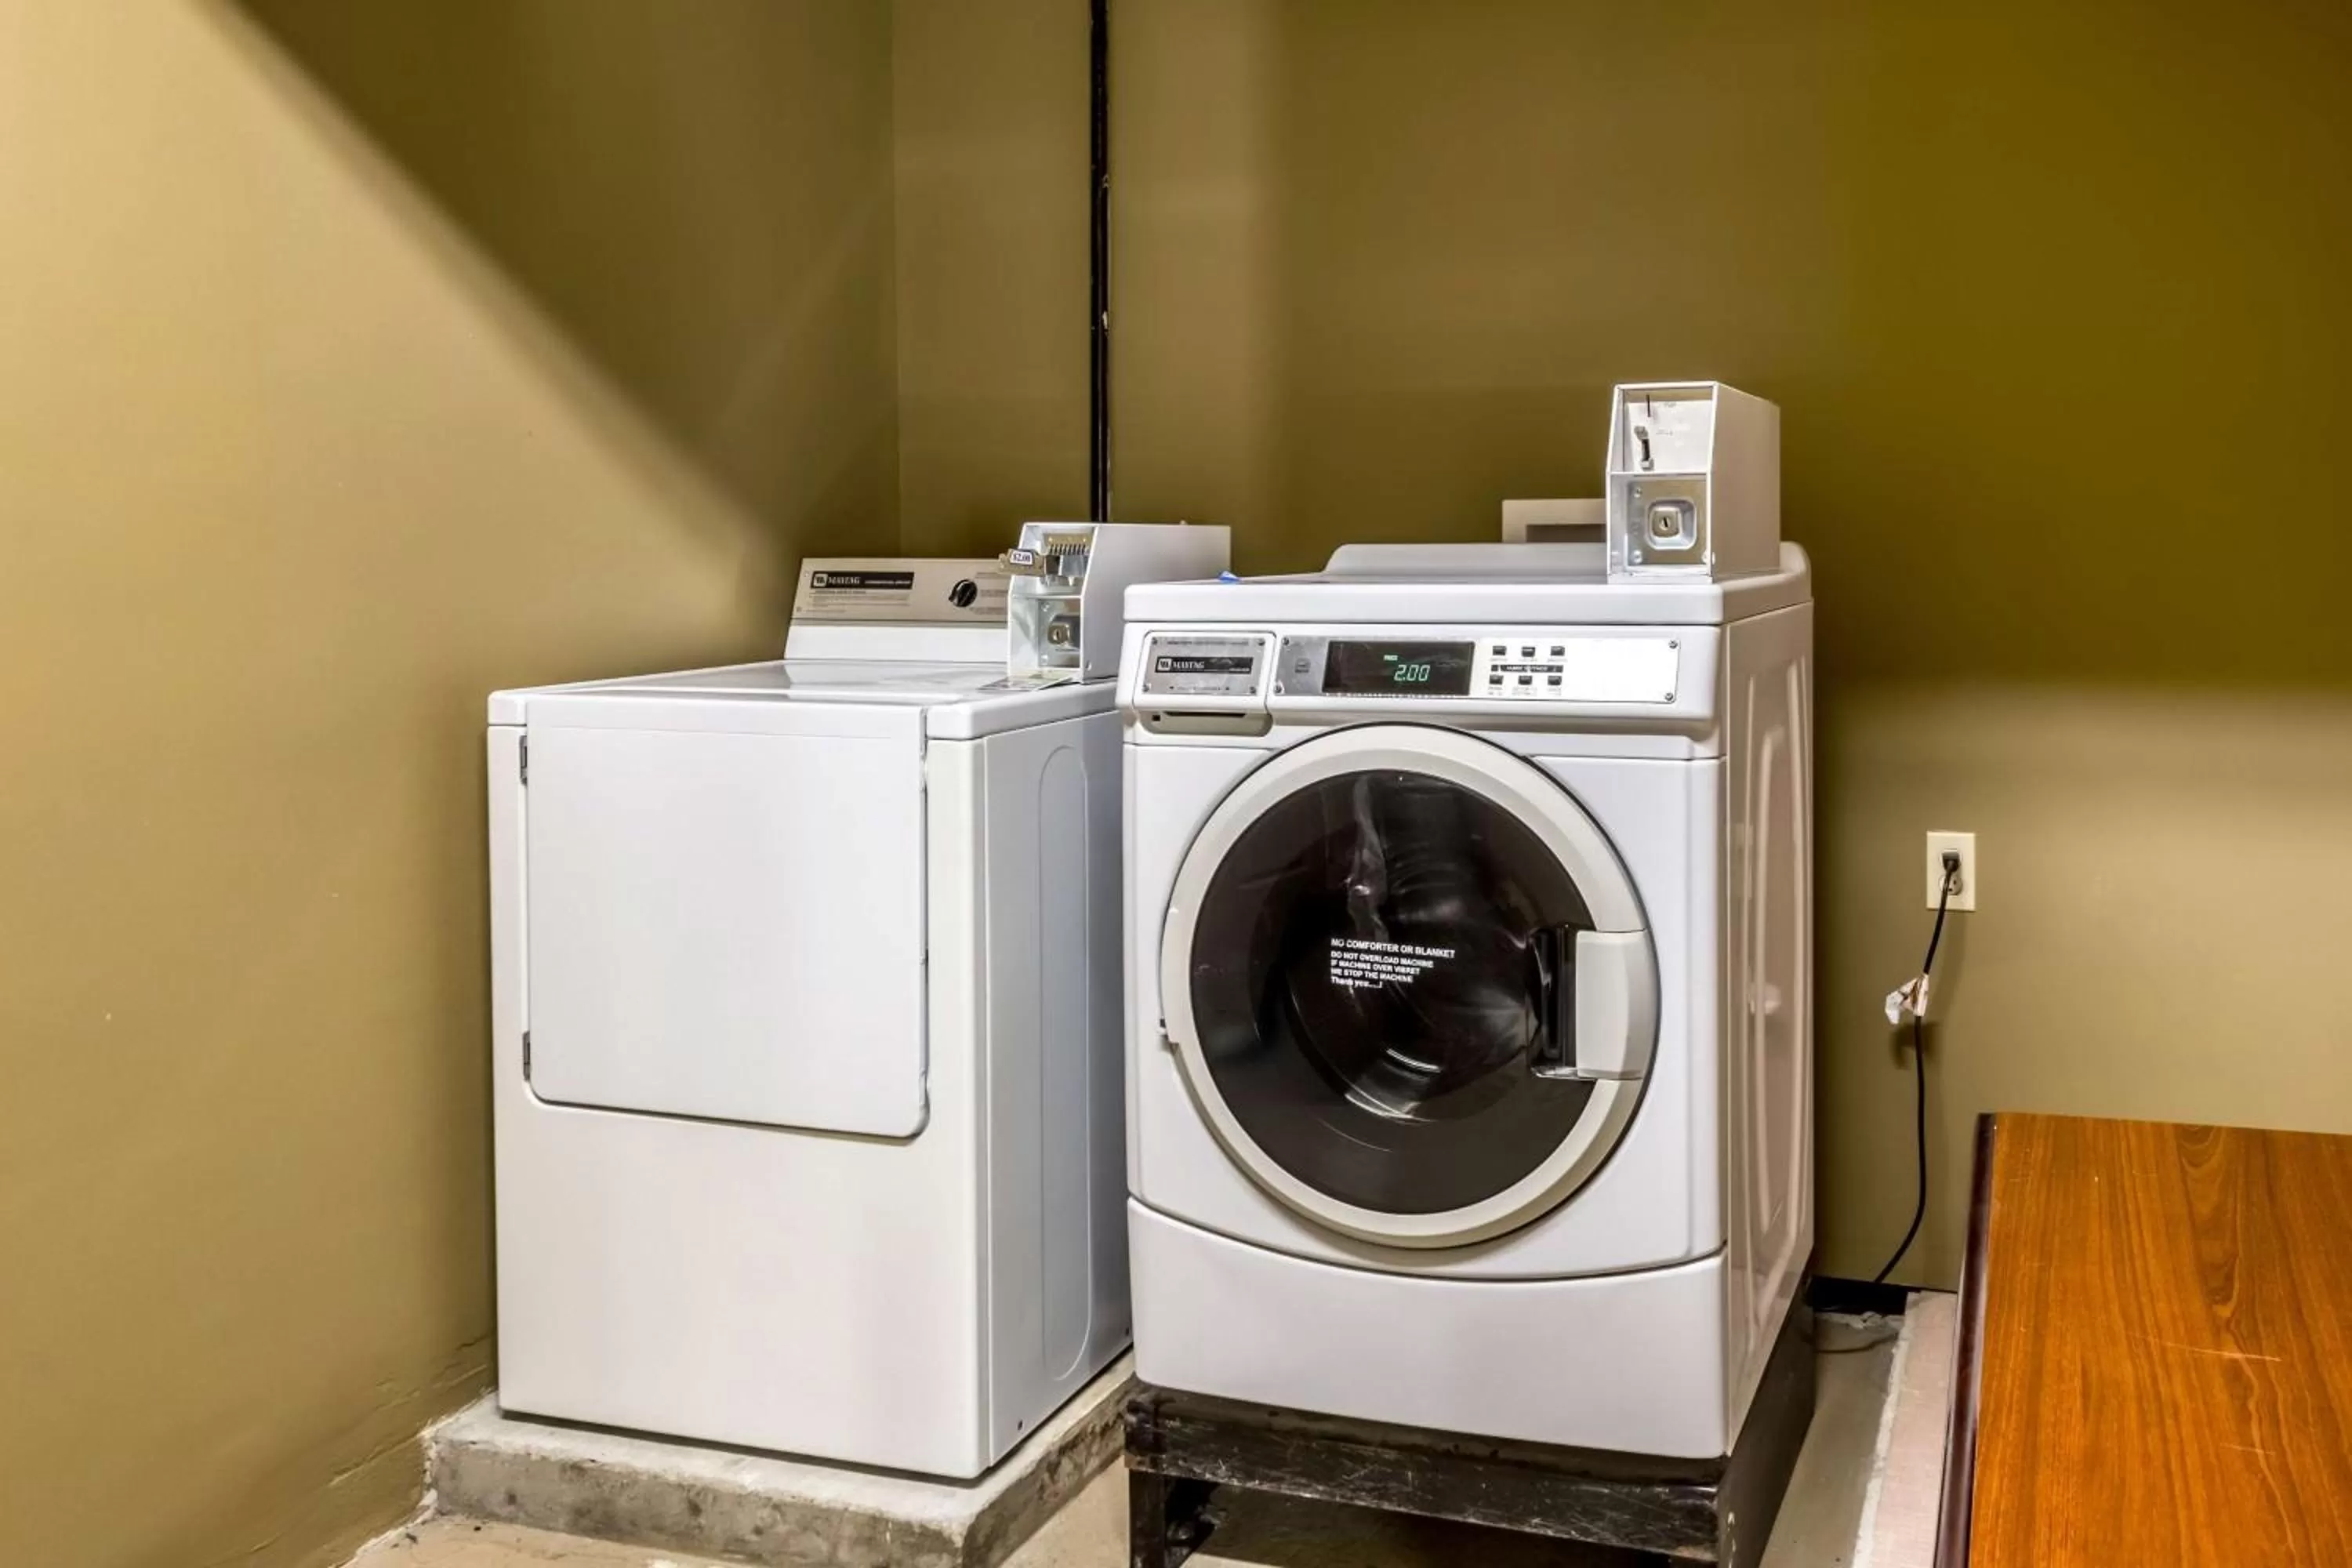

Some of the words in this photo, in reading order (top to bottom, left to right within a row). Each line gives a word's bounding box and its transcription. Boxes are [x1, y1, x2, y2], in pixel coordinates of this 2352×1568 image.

[1393, 664, 1431, 681] 2.00
[1330, 938, 1345, 947] NO
[1346, 938, 1399, 953] COMFORTER
[1400, 945, 1414, 954] OR
[1414, 946, 1456, 959] BLANKET
[1338, 960, 1371, 970] MACHINE
[1373, 964, 1392, 972] OVER
[1359, 953, 1399, 964] OVERLOAD
[1399, 957, 1434, 968] MACHINE
[1330, 967, 1343, 976] WE
[1343, 969, 1363, 978] STOP
[1364, 971, 1378, 979] THE
[1379, 972, 1414, 983] MACHINE
[1330, 976, 1353, 985] Thank
